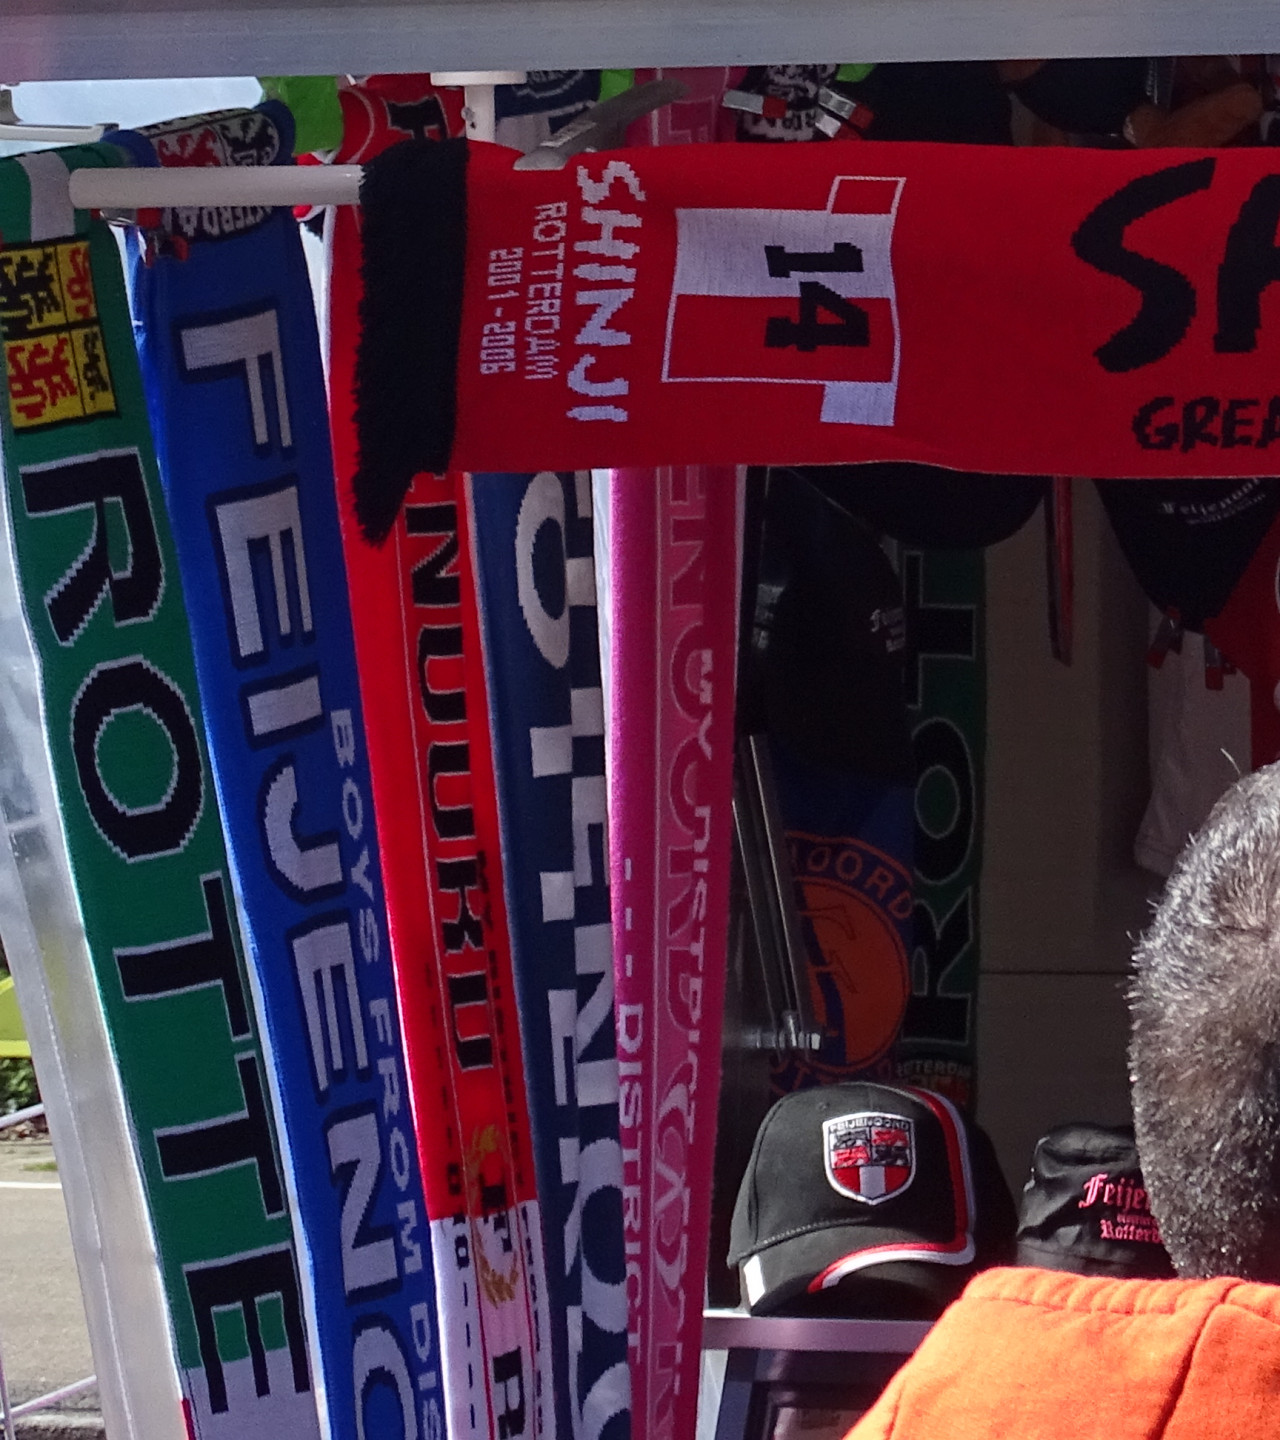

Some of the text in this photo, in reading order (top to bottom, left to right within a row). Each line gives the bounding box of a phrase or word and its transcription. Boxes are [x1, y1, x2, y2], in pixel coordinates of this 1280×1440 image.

[525, 201, 567, 382] ROTTERDAM
[566, 159, 646, 424] SHINJI
[764, 242, 870, 353] 14
[329, 709, 381, 963] BOYS
[368, 997, 424, 1275] FROM
